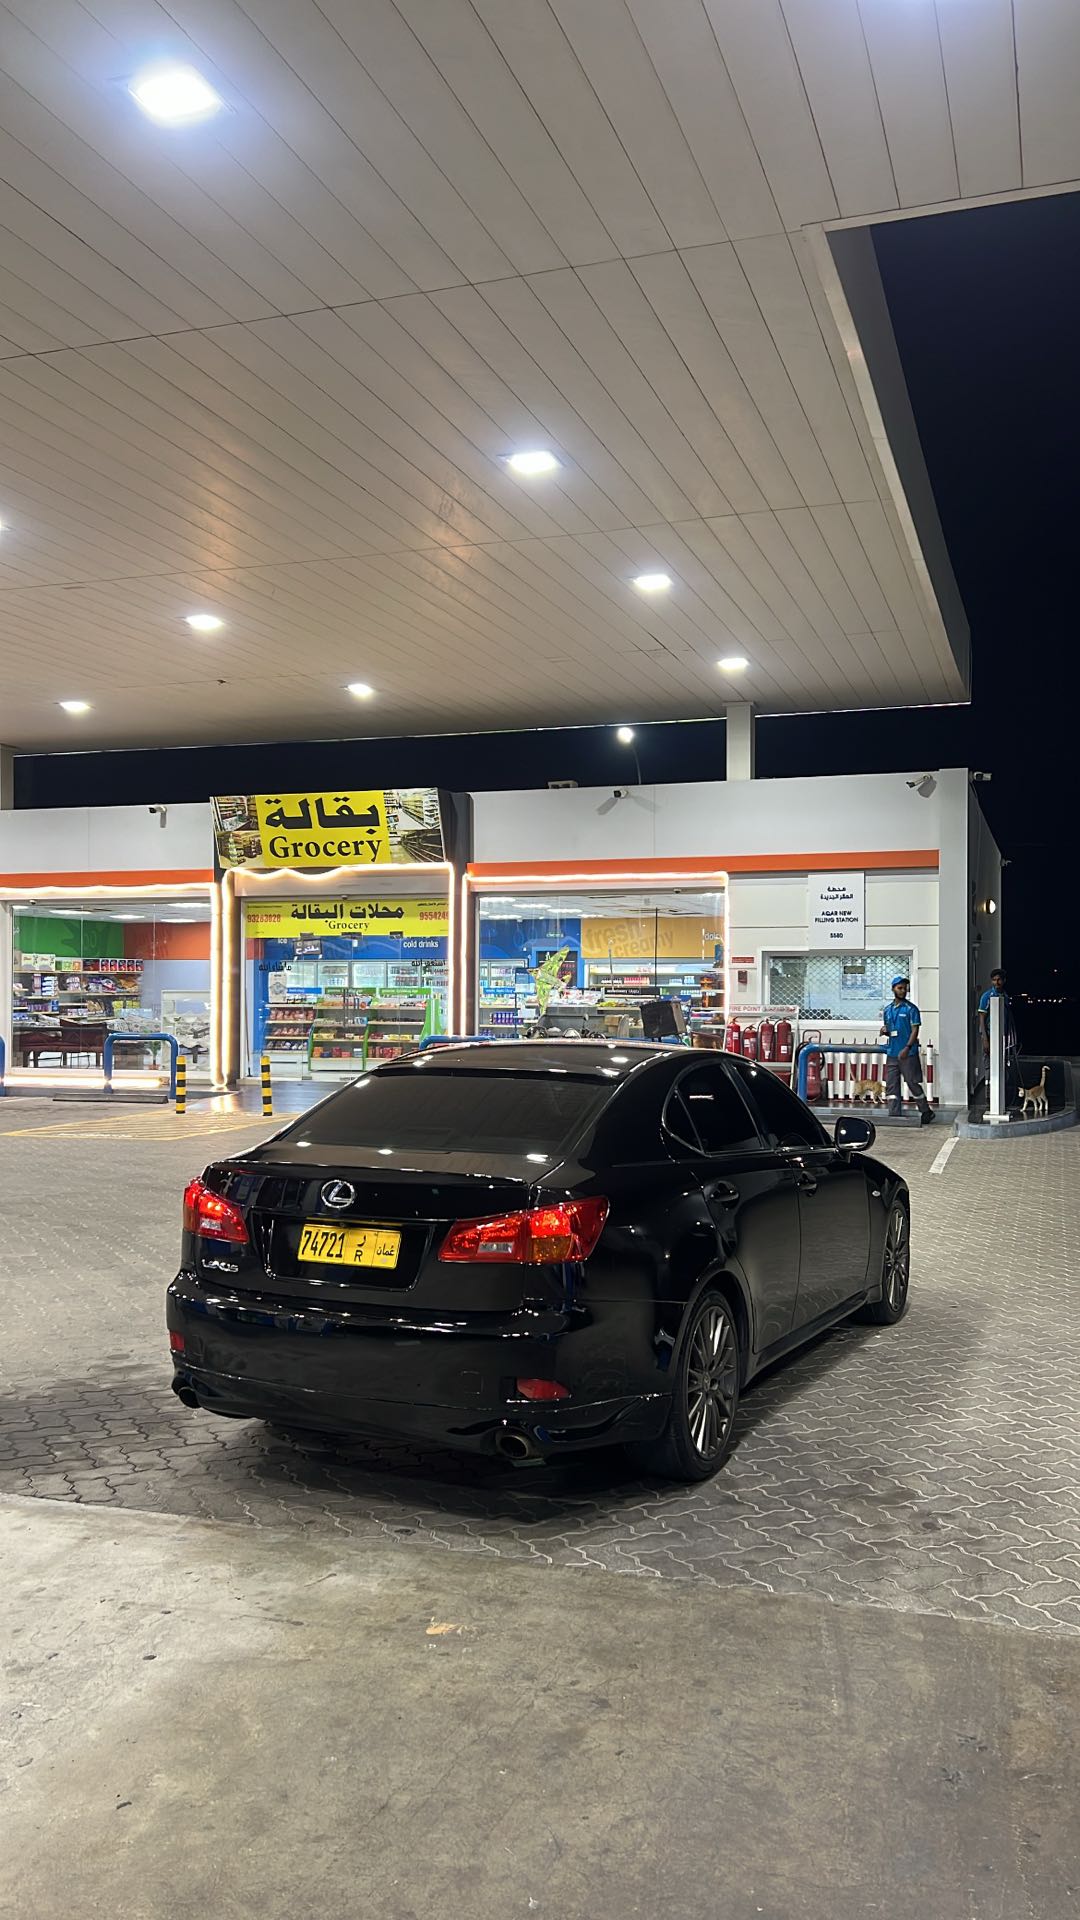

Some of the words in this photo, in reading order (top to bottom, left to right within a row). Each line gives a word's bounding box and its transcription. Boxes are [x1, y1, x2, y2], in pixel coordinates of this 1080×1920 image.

[265, 796, 381, 835] بقالة
[269, 836, 382, 862] Grocery
[291, 903, 344, 923] البقالة
[350, 903, 405, 919] محلات
[328, 920, 370, 932] Grocery
[586, 918, 643, 950] fresh
[403, 940, 417, 948] cold
[418, 940, 439, 948] drinks
[614, 929, 674, 957] creamy
[302, 1231, 345, 1258] 74721
[353, 1249, 363, 1262] R
